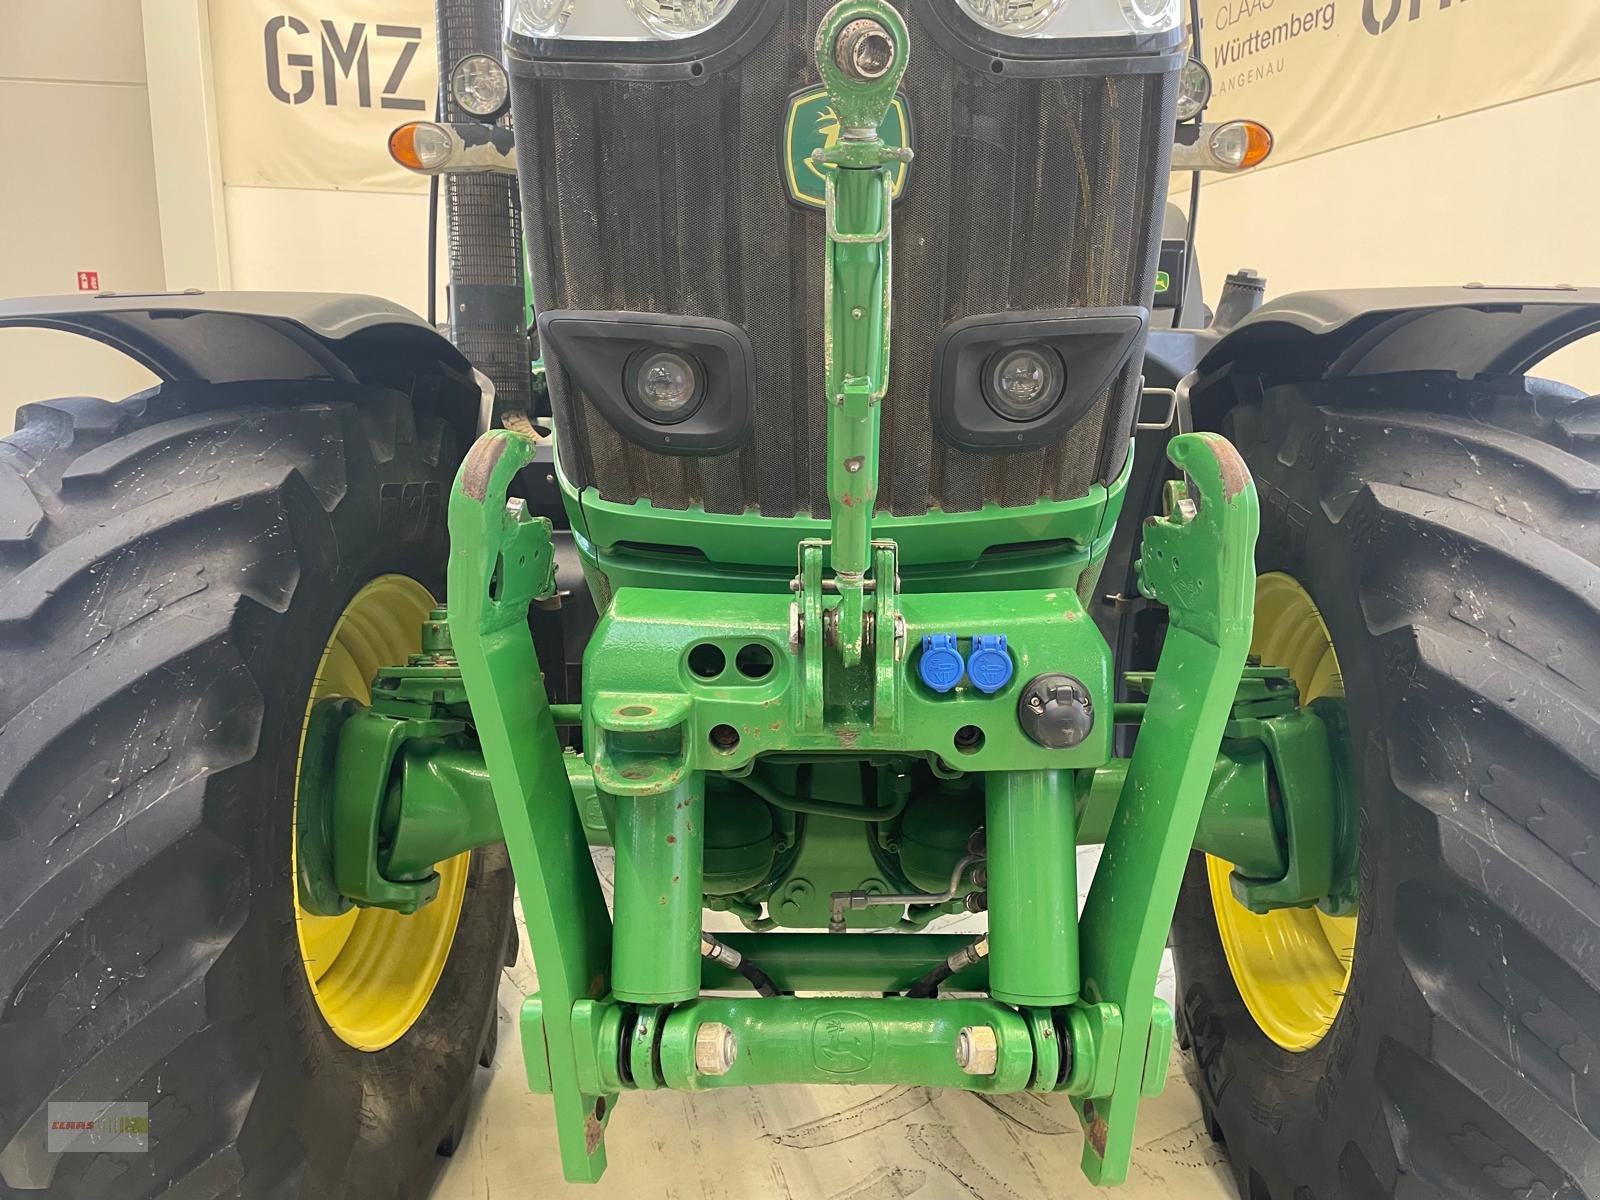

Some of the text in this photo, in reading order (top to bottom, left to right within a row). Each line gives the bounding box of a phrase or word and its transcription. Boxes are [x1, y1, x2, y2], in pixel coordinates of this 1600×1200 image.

[264, 15, 426, 111] GMZ
[1214, 2, 1335, 69] Württemberg
[1212, 57, 1285, 97] ANGENAU
